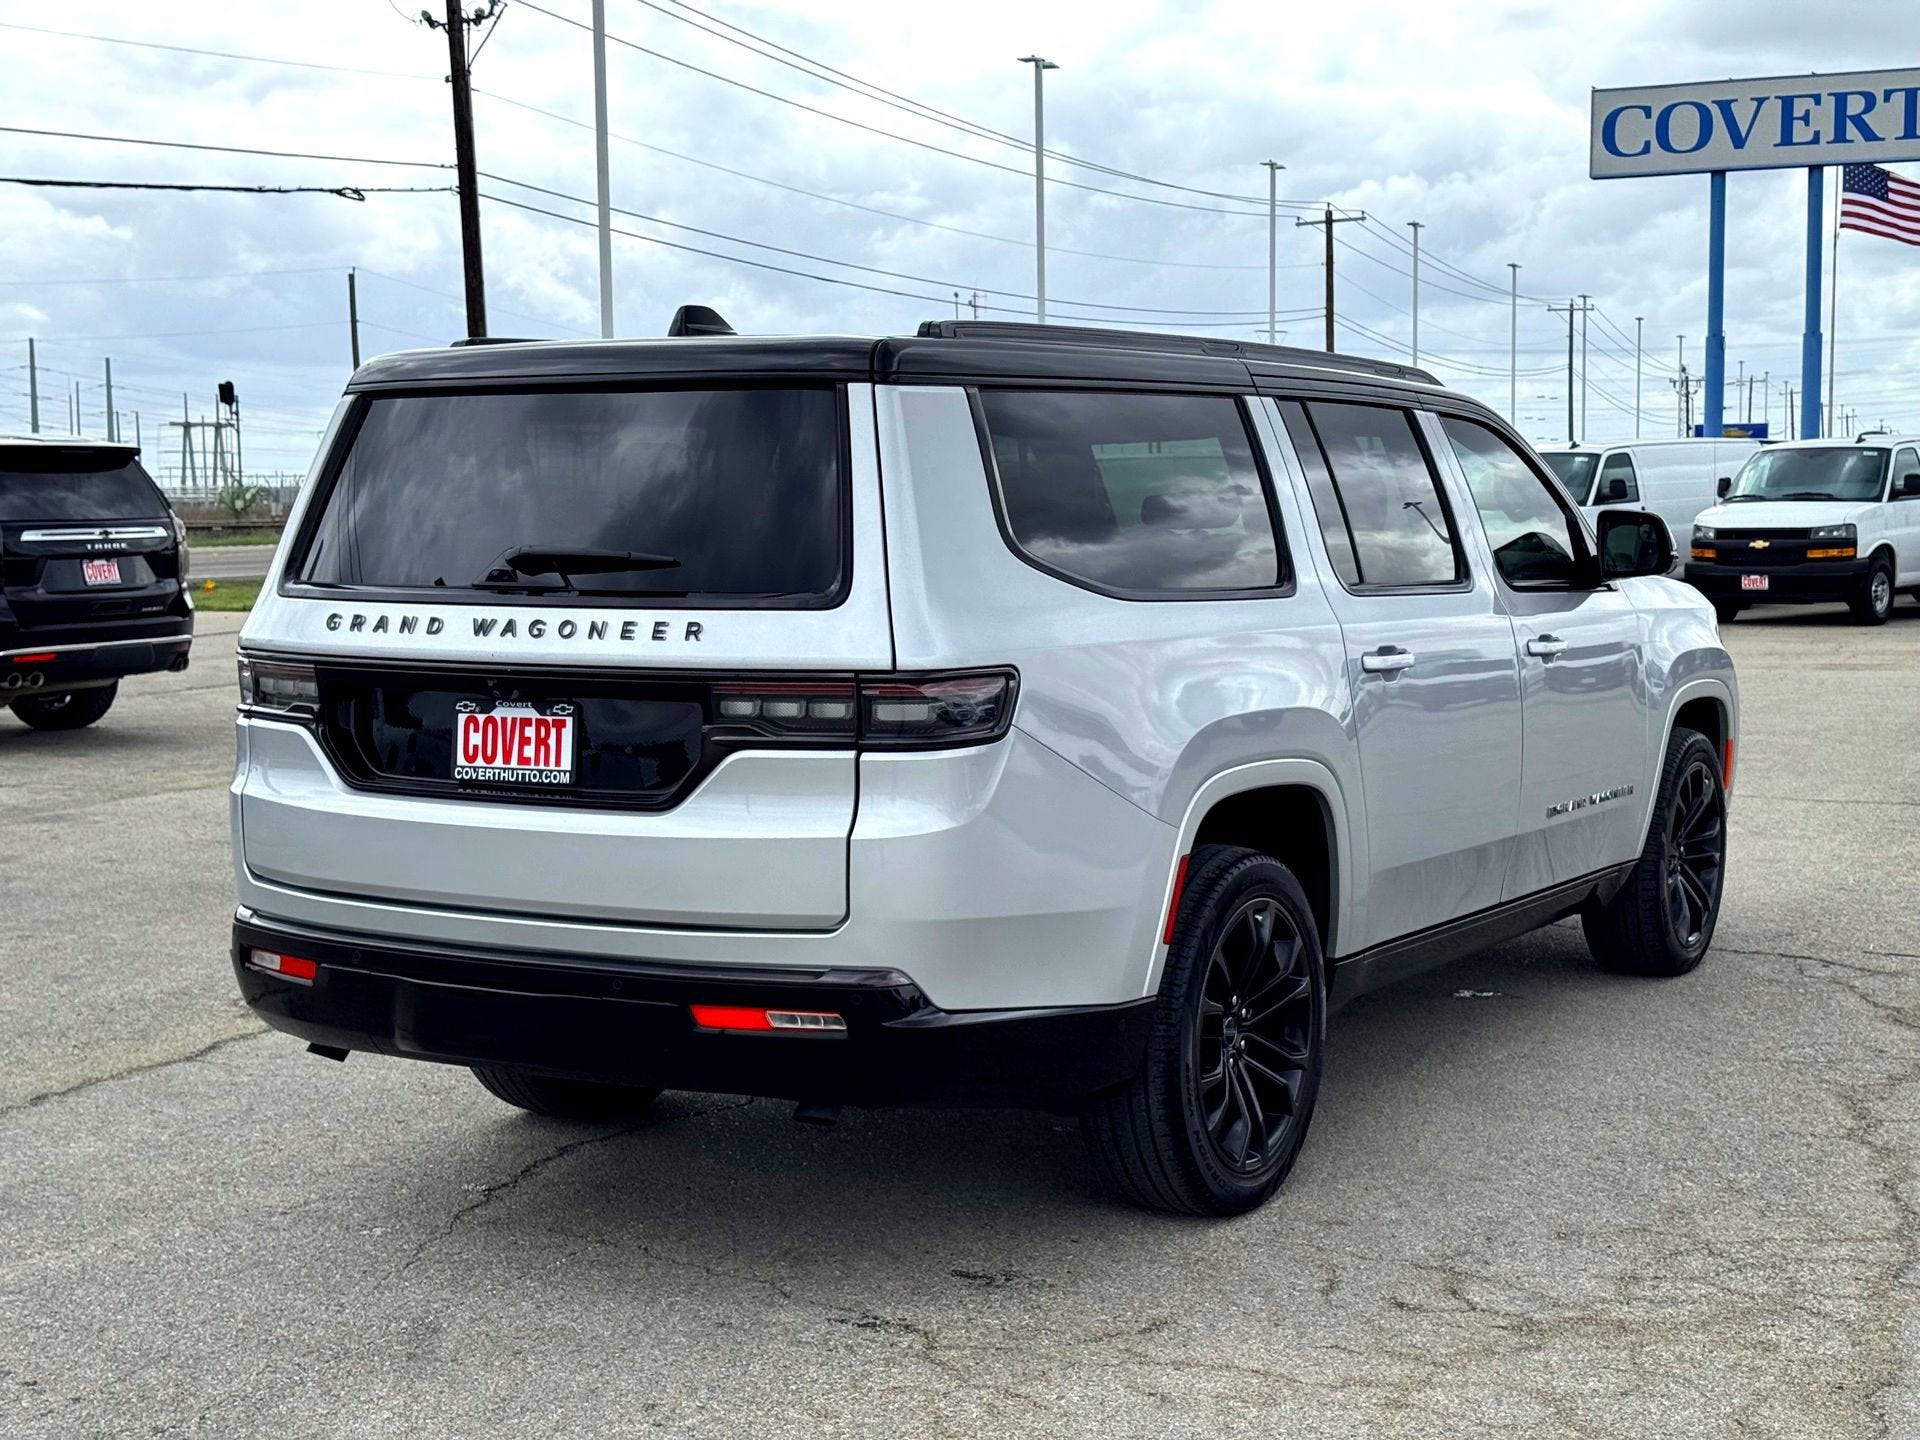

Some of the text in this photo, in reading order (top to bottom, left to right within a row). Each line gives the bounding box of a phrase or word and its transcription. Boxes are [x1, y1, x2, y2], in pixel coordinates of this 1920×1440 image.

[1602, 87, 1920, 157] COVERT
[86, 542, 128, 551] TAHOE
[86, 563, 118, 581] COVERT
[326, 613, 704, 642] GRAND WAGONEER
[495, 700, 533, 709] Covert
[463, 714, 567, 768] COVERT
[454, 767, 571, 785] COVERTHUTTO.COM
